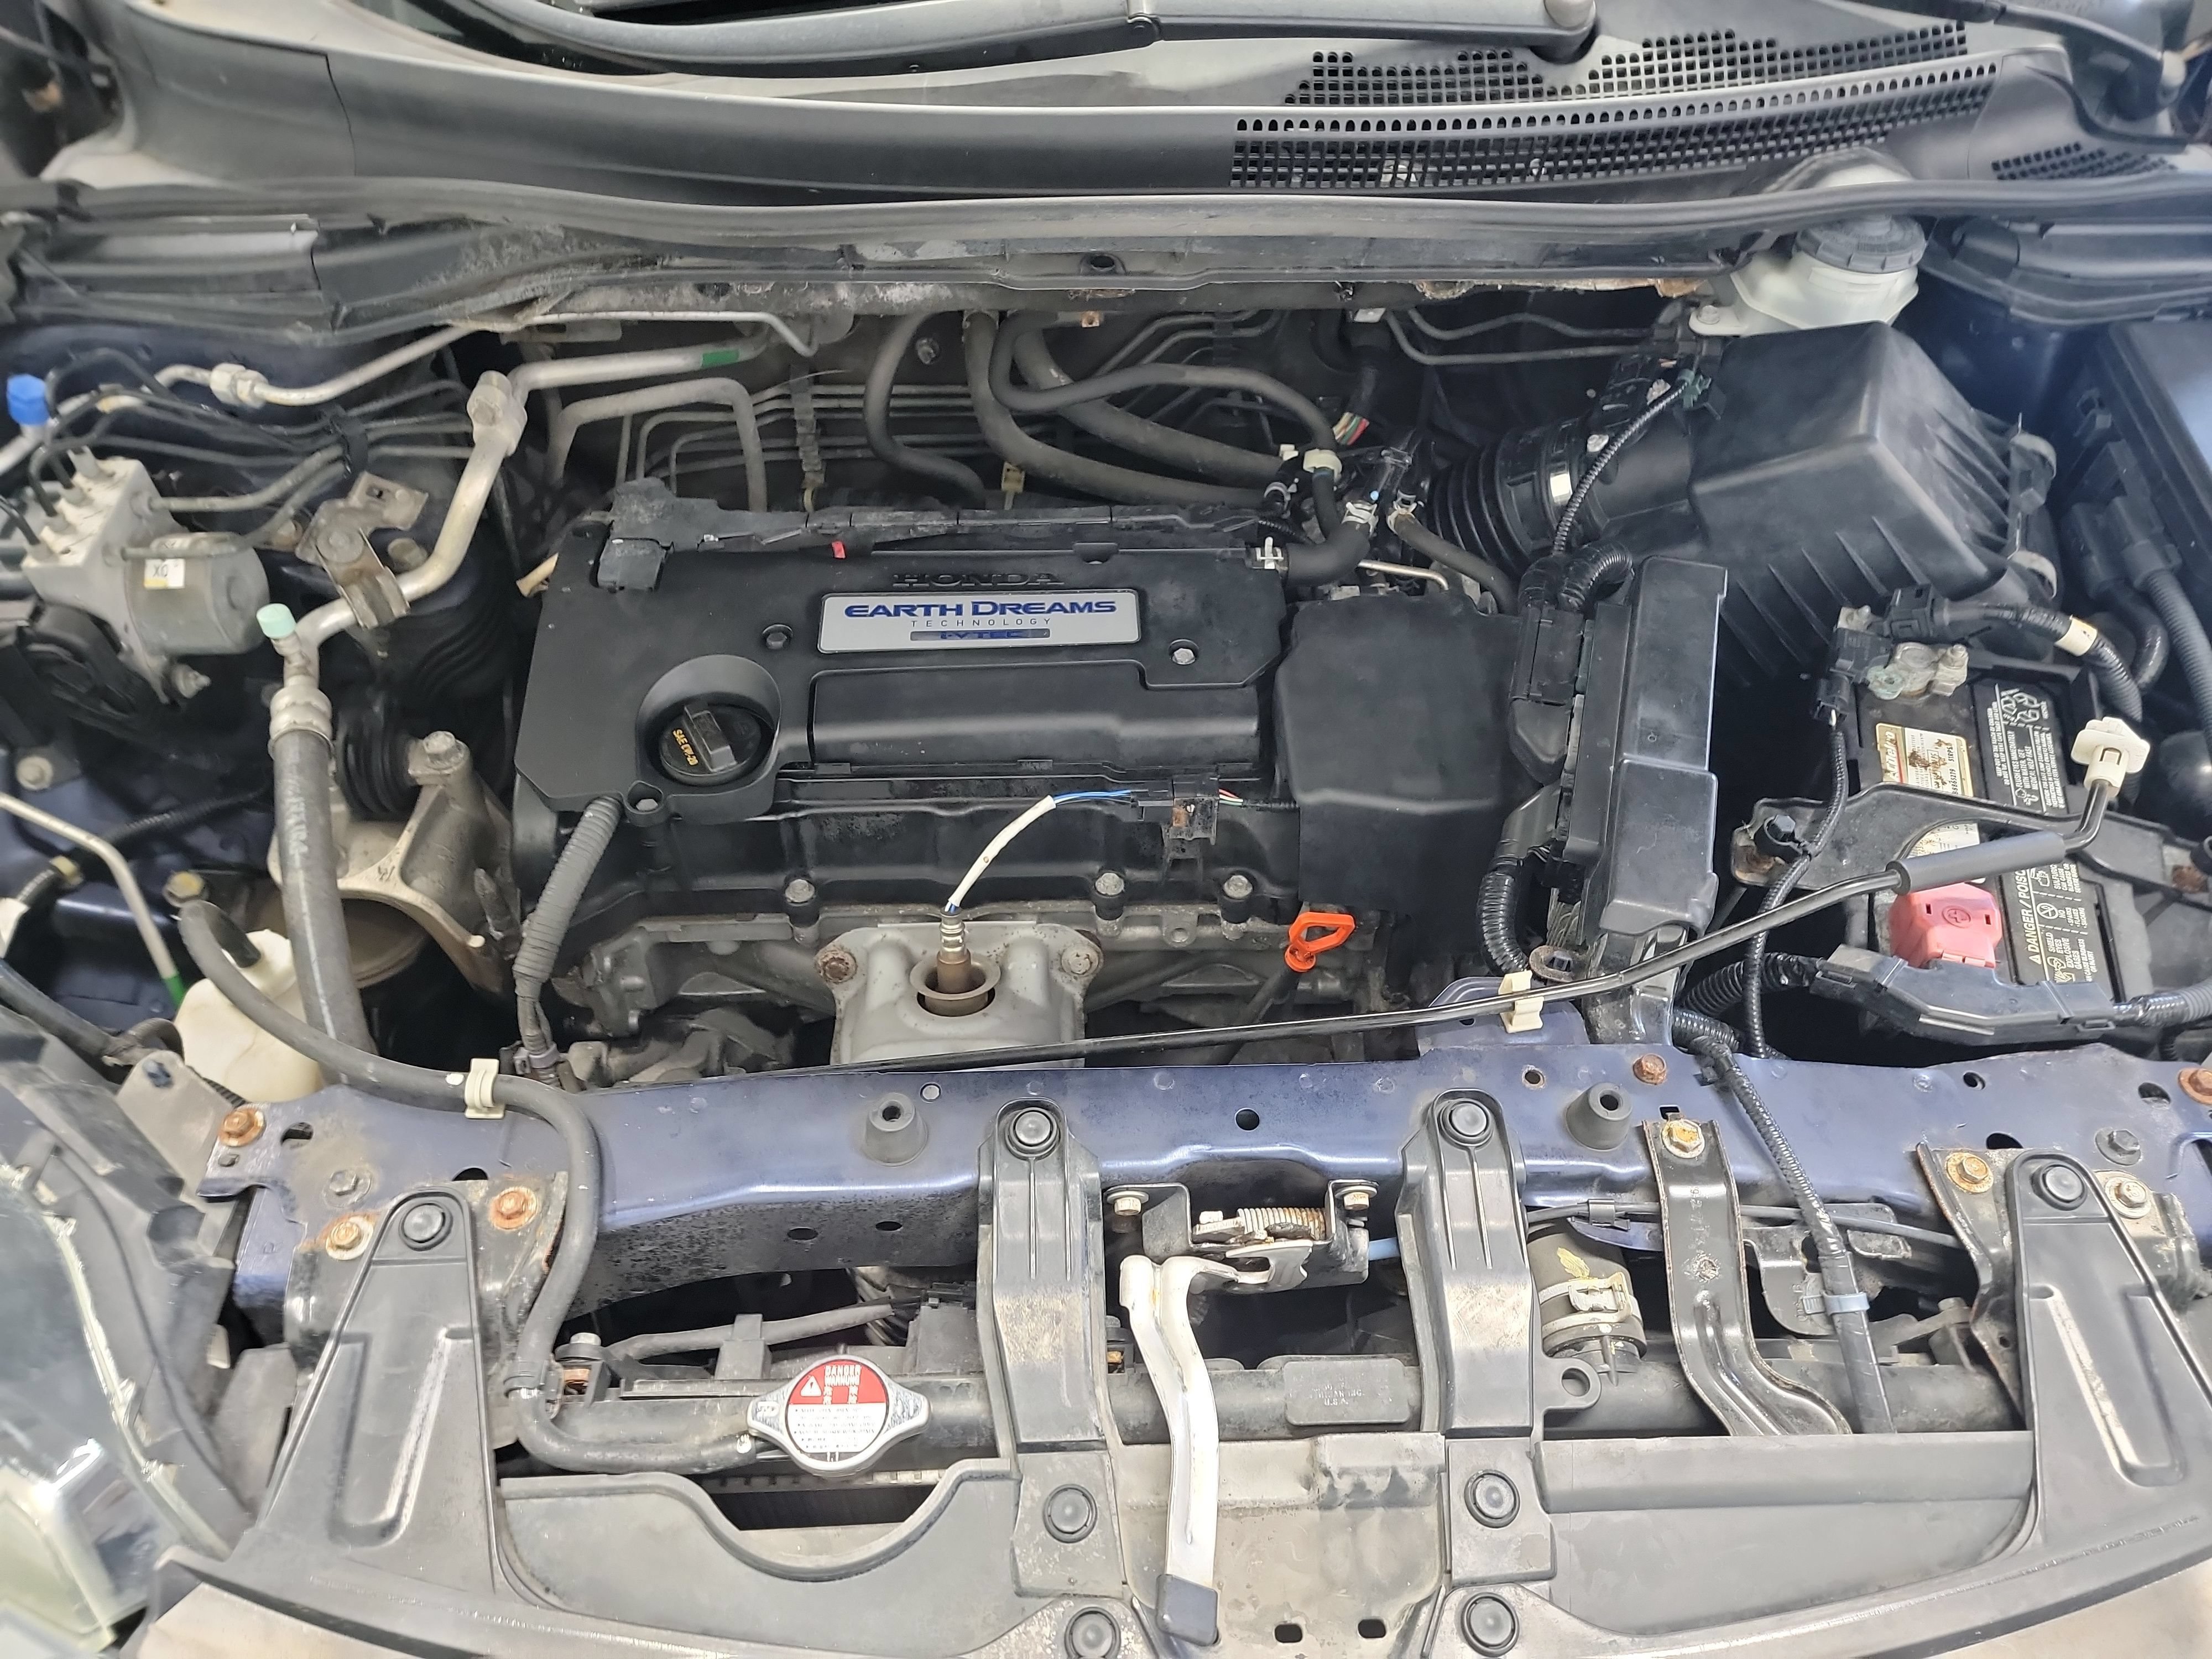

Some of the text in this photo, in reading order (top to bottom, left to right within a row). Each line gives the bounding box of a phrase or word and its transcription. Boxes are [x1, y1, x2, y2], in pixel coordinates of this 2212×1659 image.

[844, 601, 1118, 618] EARTH DREAMS
[911, 618, 1051, 628] TECHNOLOGY
[2012, 760, 2020, 773] EYES
[2025, 746, 2038, 790] MEDICAL HELP FAST
[2014, 773, 2023, 788] FLUSH
[2022, 776, 2031, 789] WITH
[2058, 909, 2066, 919] NO
[2046, 932, 2056, 952] SHIELD
[2054, 938, 2064, 954] EYES
[2062, 937, 2074, 968] EXPLOSIVE
[2072, 950, 2083, 969] GASES
